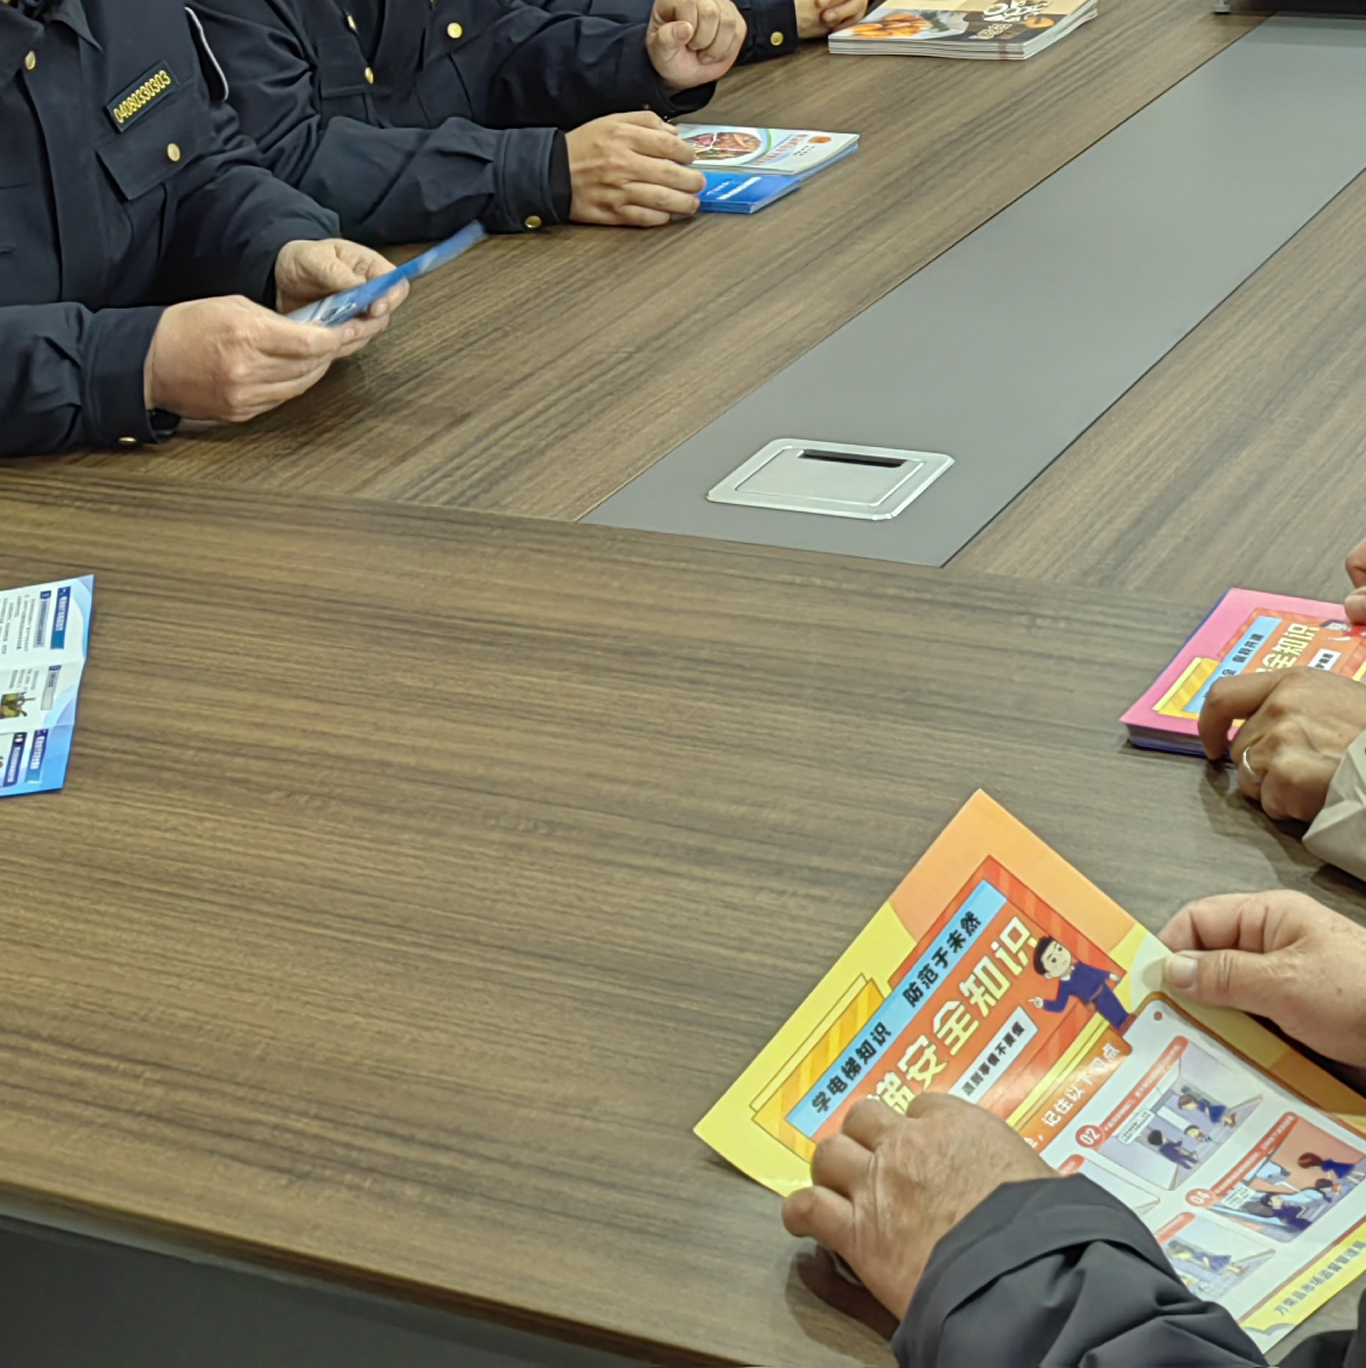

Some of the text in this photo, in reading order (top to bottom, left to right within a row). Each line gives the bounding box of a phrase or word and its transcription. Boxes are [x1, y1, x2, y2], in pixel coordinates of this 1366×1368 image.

[1255, 623, 1320, 674] 全知识
[811, 910, 982, 1114] 学电梯知识 防范于未然
[1080, 1127, 1100, 1148] 02
[1189, 1188, 1209, 1209] 04
